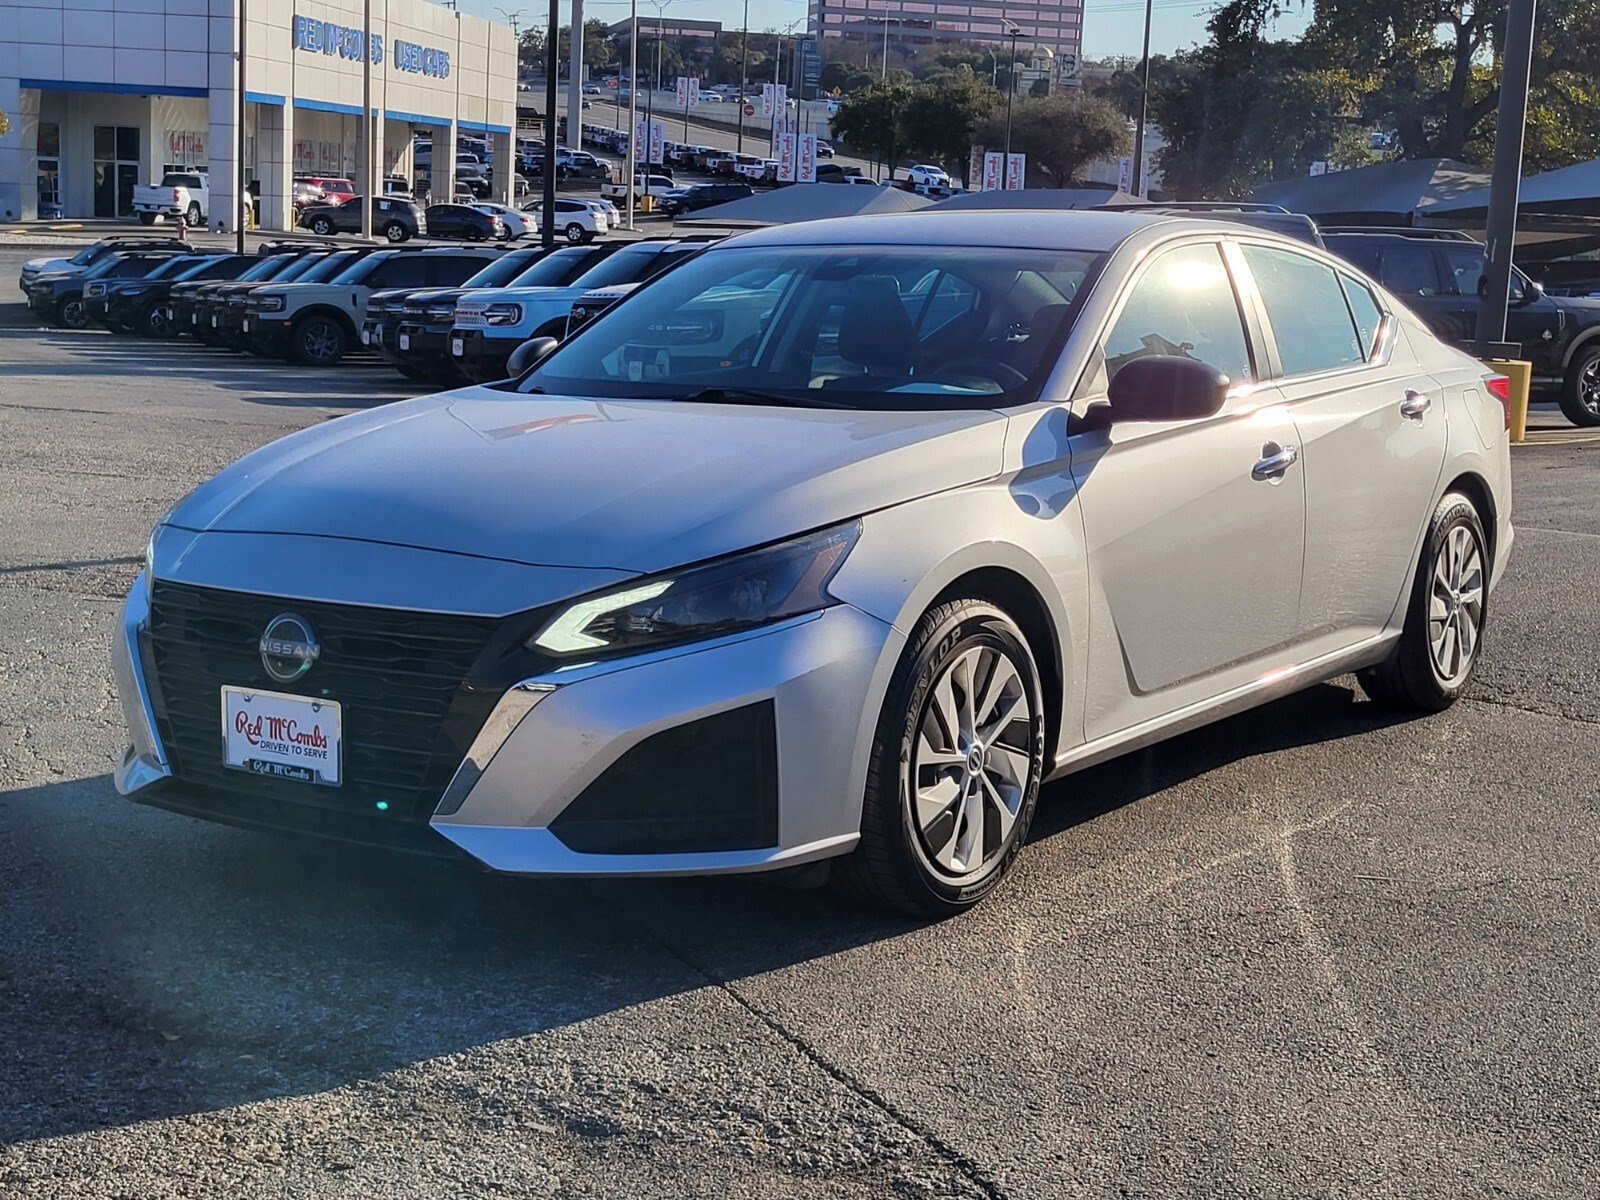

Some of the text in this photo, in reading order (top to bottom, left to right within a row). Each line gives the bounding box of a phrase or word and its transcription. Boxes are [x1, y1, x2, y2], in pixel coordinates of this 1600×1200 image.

[292, 15, 324, 52] RED
[394, 39, 450, 78] USED CARS
[260, 638, 318, 657] NISSAN
[904, 627, 962, 740] DUNLOP
[235, 711, 328, 749] Red McCombs
[260, 741, 327, 759] DRIVEN TO SERVE
[253, 760, 309, 780] Red McCombs
